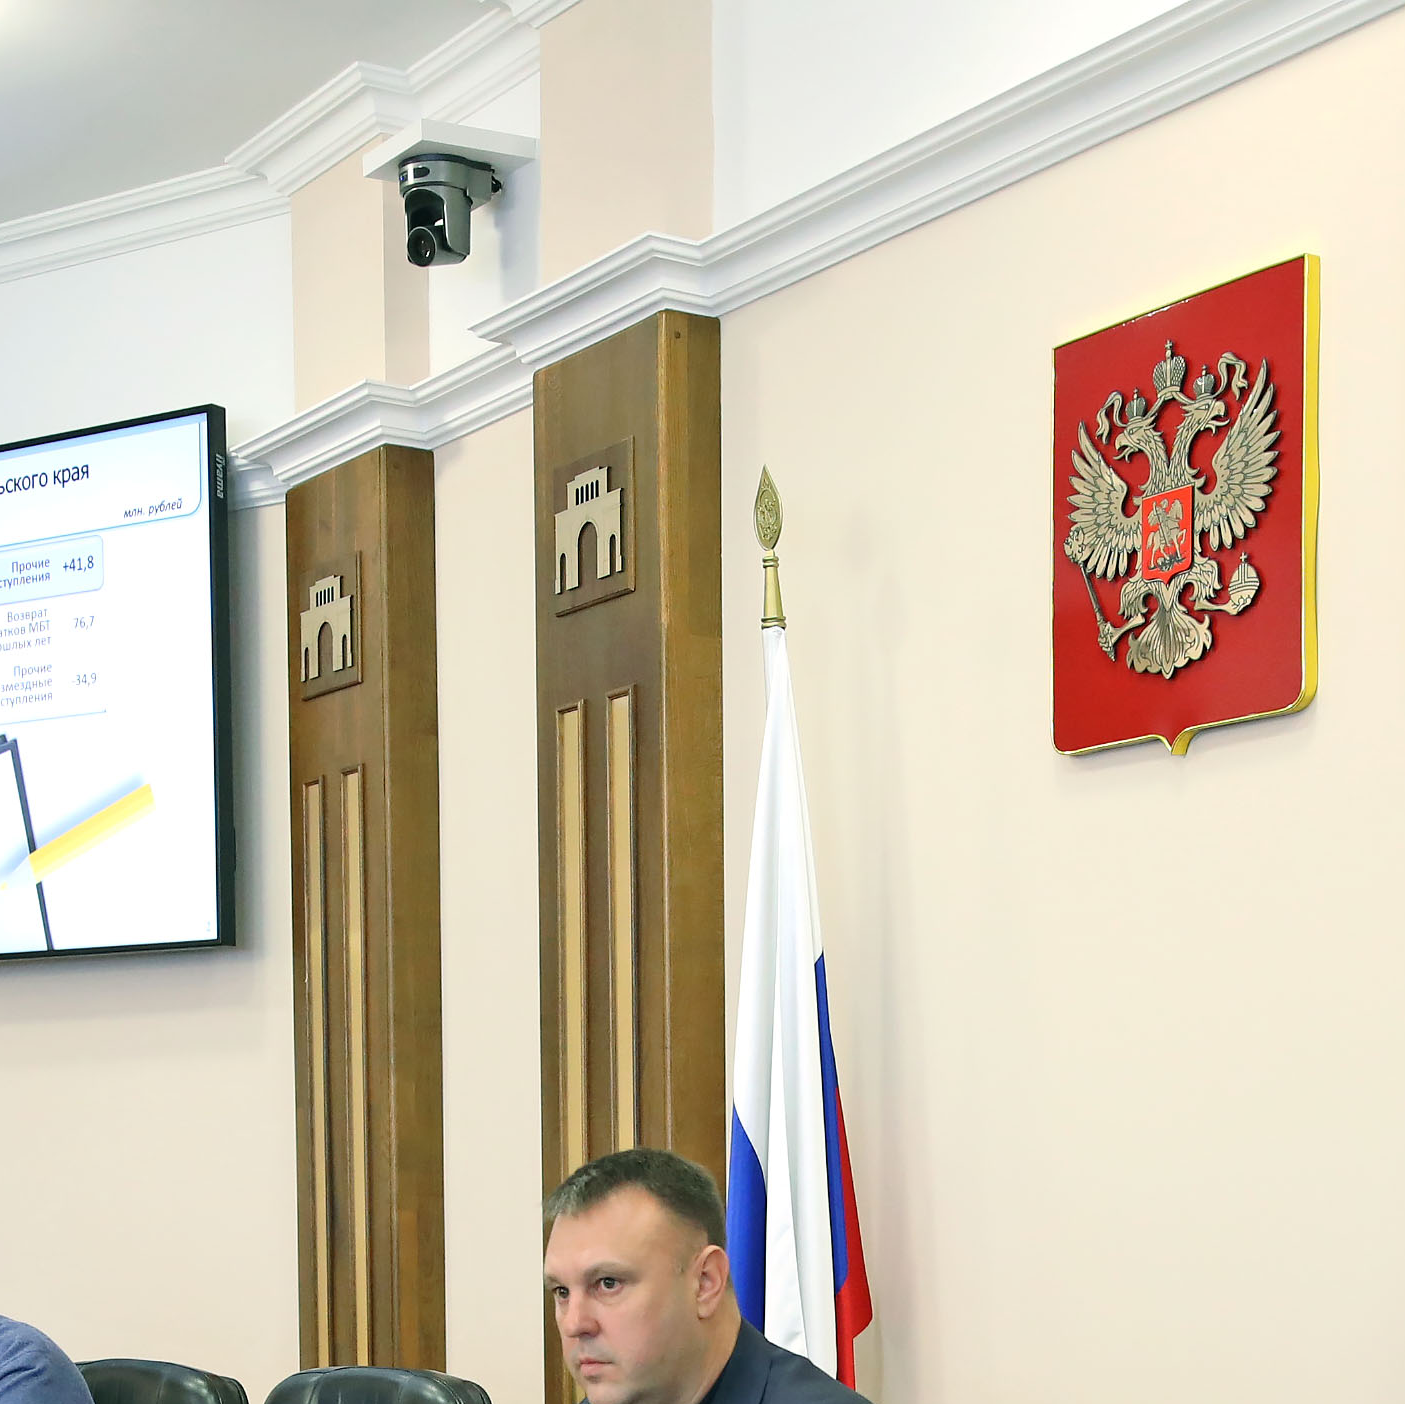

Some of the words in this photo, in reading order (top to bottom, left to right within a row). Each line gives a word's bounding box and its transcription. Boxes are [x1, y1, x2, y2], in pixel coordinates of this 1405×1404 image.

[53, 463, 90, 488] края
[215, 453, 226, 499] iiyama
[123, 507, 145, 519] млн.
[148, 497, 183, 517] рублей
[11, 558, 50, 574] Прочие
[62, 554, 94, 573] +41,8
[7, 608, 48, 623] Возврат
[73, 615, 95, 630] 76,7
[29, 619, 50, 633] МБТ
[34, 636, 52, 647] лет
[13, 663, 53, 678] Прочие
